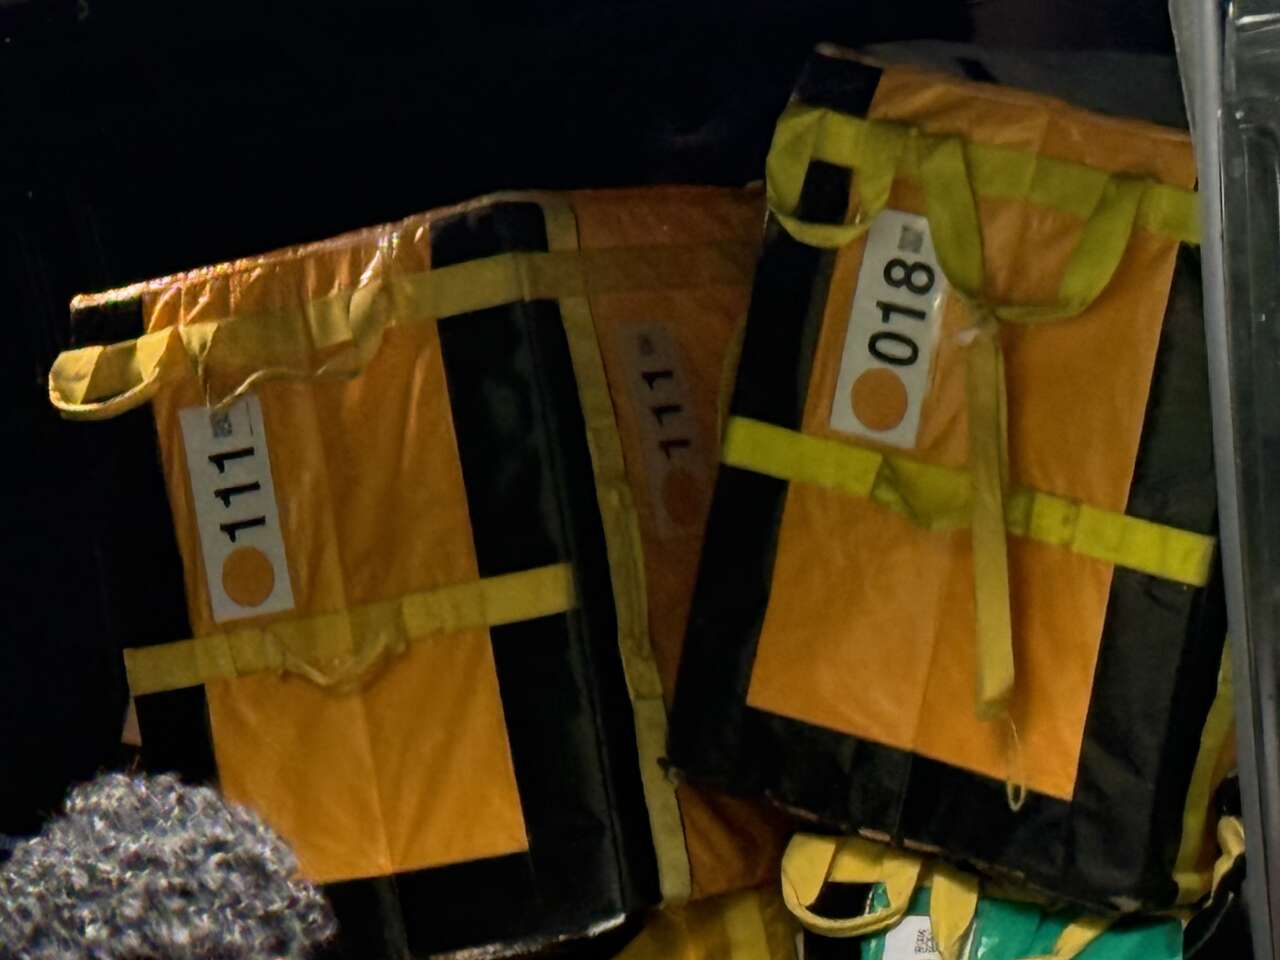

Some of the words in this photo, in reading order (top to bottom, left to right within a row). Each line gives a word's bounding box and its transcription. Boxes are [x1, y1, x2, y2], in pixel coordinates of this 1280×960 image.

[868, 258, 935, 366] 018
[642, 370, 691, 460] 111
[208, 447, 266, 543] 111
